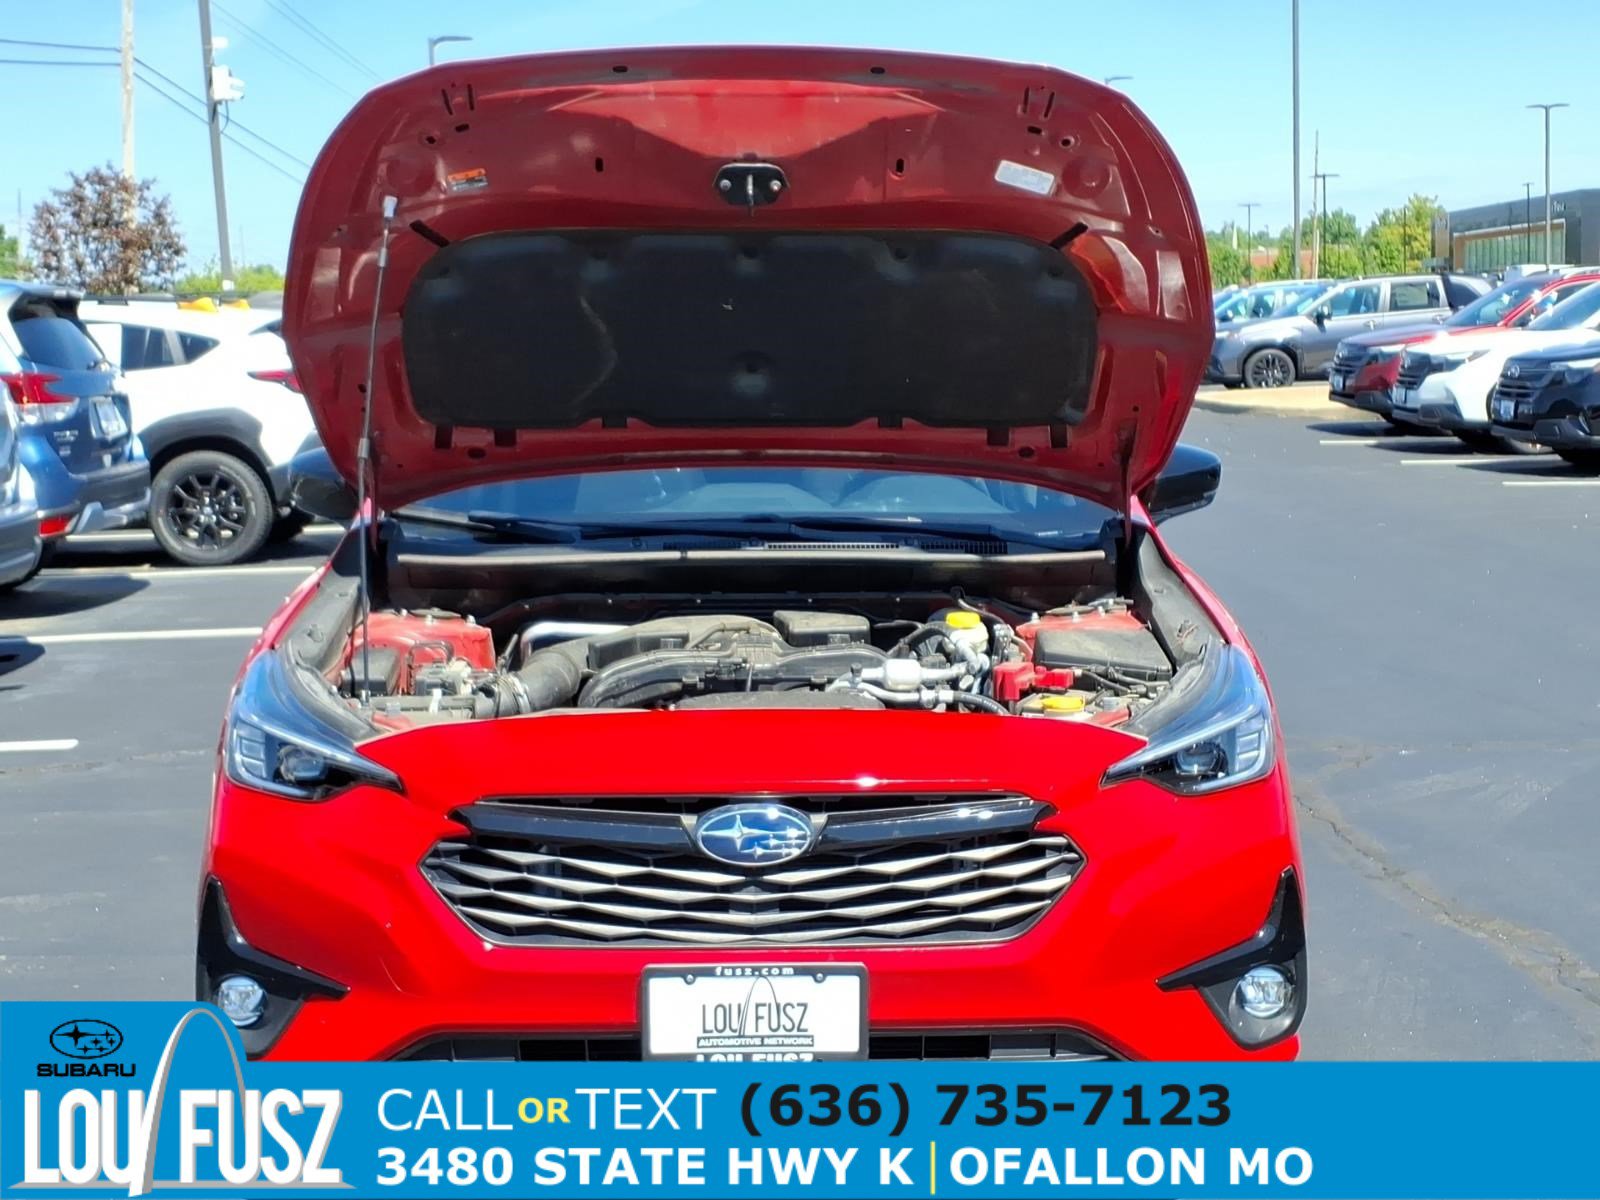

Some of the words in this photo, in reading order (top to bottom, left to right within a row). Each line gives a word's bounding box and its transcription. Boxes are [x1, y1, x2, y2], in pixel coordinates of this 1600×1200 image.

[715, 966, 795, 976] fusz.com
[702, 1003, 742, 1034] LOU
[755, 1002, 809, 1033] FUSZ
[698, 1037, 762, 1047] AUTOMOTIVE
[763, 1036, 814, 1047] NETWORK
